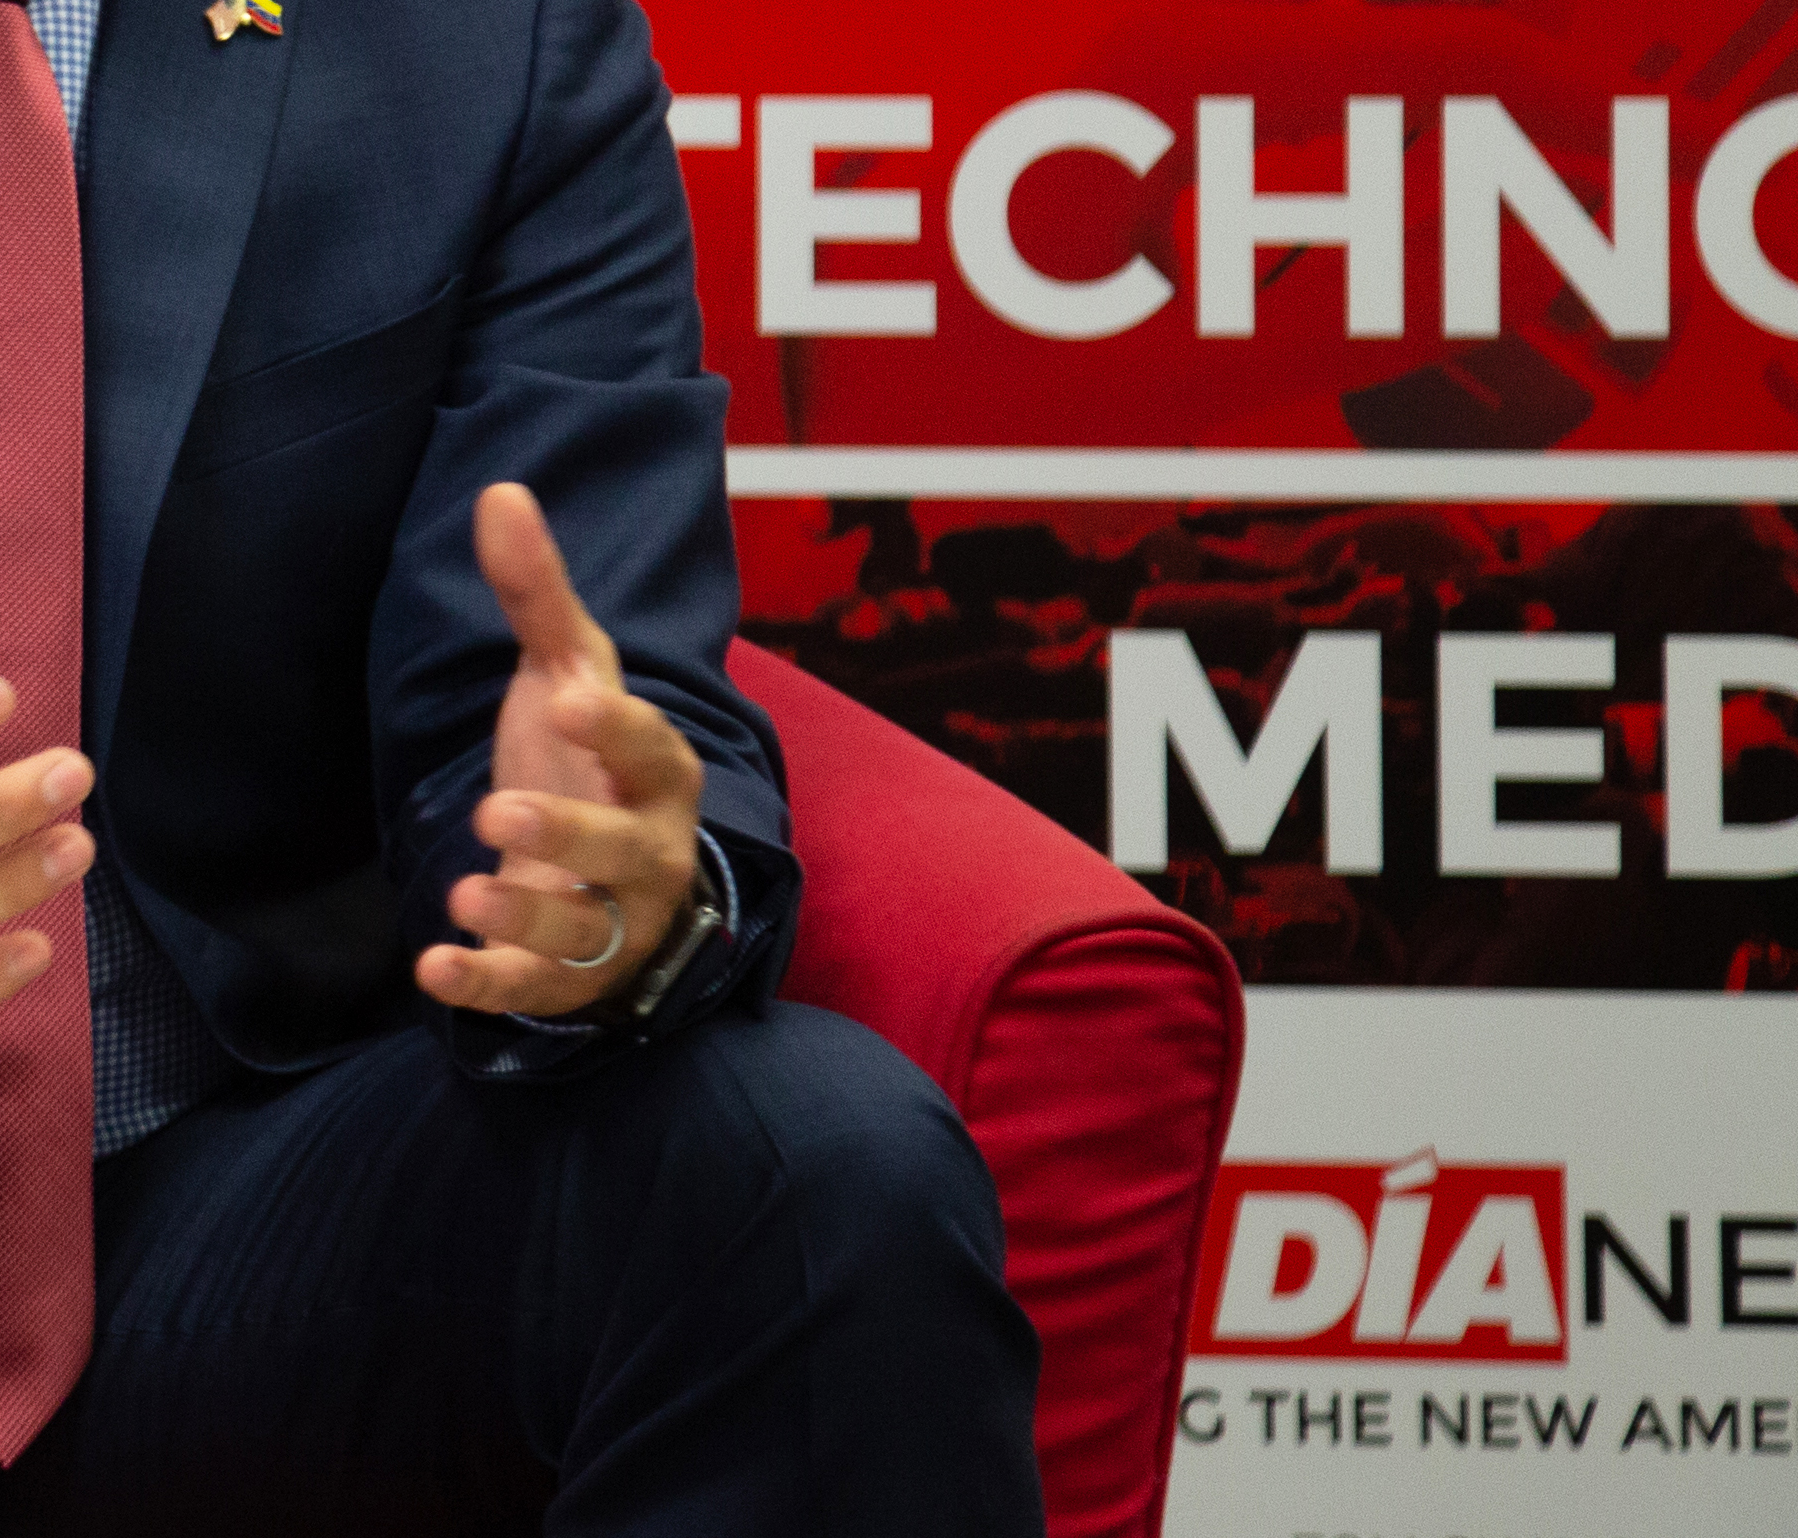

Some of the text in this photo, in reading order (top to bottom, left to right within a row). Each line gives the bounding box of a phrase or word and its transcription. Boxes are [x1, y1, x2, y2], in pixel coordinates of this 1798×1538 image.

[667, 89, 1798, 342] ECHN
[1107, 628, 1798, 879] MED
[1213, 1147, 1798, 1346] DÍA NE
[1251, 1388, 1392, 1447] THE
[1421, 1393, 1597, 1450] NEW
[1620, 1396, 1793, 1455] AME
